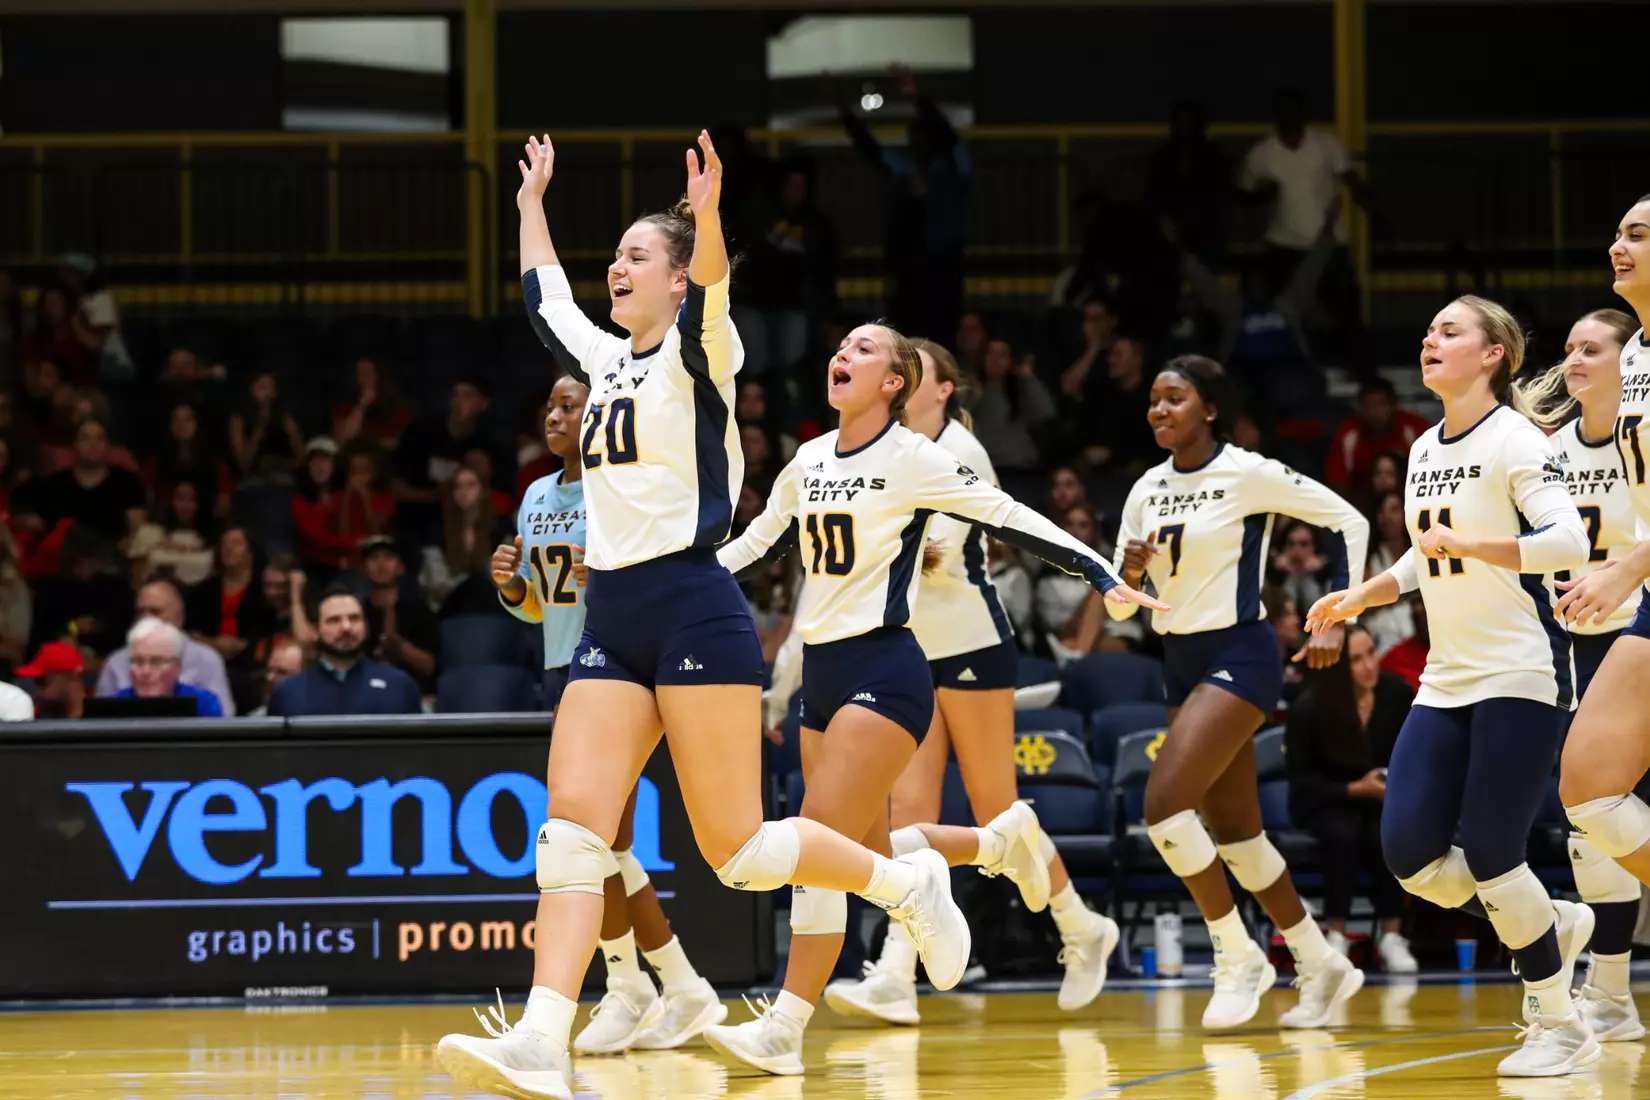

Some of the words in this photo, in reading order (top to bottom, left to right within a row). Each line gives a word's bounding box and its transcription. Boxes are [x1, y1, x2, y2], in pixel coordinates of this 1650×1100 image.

[583, 397, 639, 471] 20
[803, 477, 886, 490] KANSAS
[1410, 465, 1482, 485] KANSAS
[1565, 468, 1627, 484] ANSA
[808, 489, 858, 502] CITY
[1416, 481, 1460, 498] CITY
[1568, 482, 1614, 495] CITY
[1148, 489, 1225, 507] KANSAS
[527, 509, 586, 523] KANSA
[1157, 502, 1203, 517] CITY
[532, 521, 574, 535] CITY
[806, 511, 855, 576] 10
[1157, 522, 1186, 578] 7
[1417, 505, 1466, 578] 11
[530, 542, 579, 606] 12
[187, 920, 355, 963] graphics
